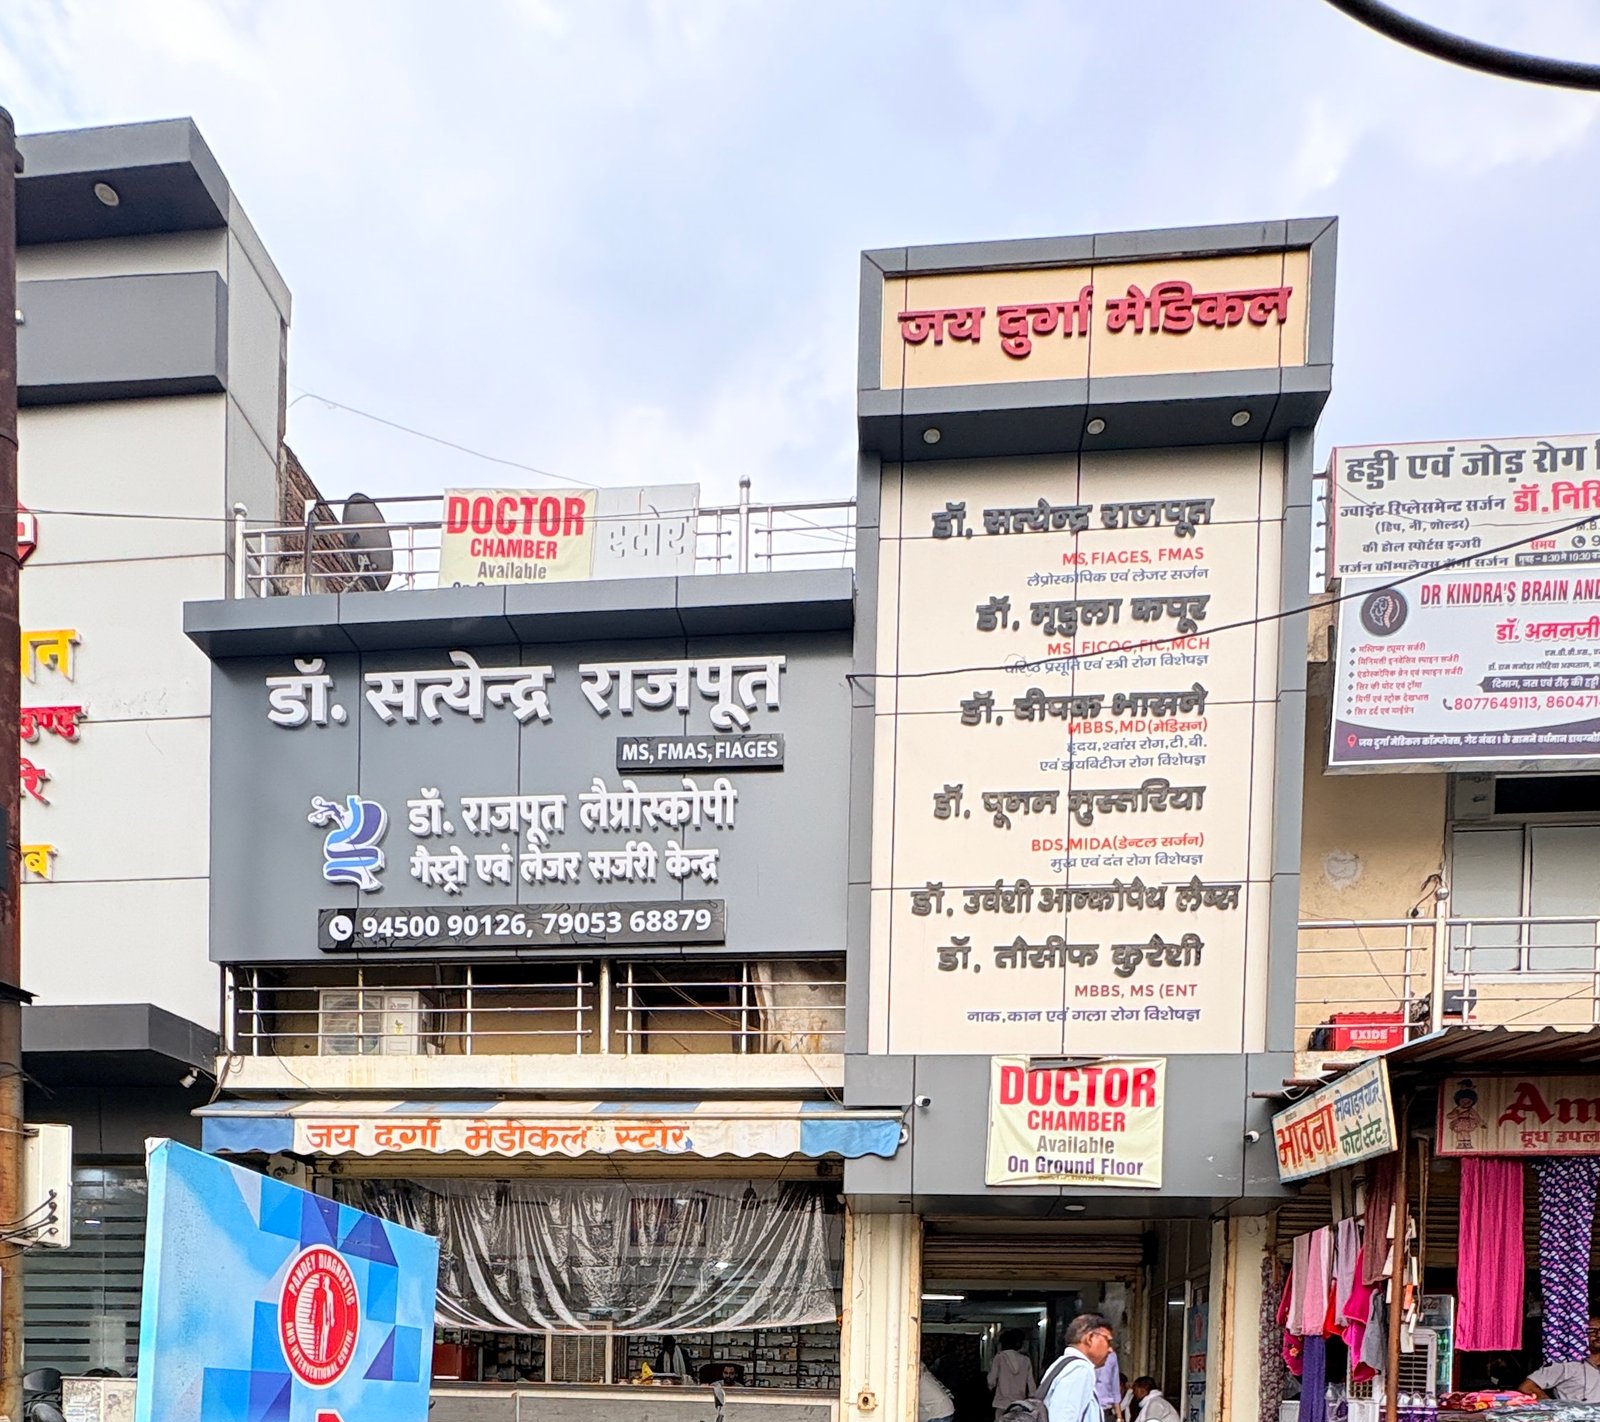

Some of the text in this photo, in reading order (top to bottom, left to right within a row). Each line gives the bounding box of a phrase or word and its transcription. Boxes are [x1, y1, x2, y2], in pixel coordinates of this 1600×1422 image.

[898, 281, 1292, 358] जय दुर्गा मेडिकल
[1345, 449, 1399, 490] हड्डी
[1406, 446, 1455, 479] एवं
[1461, 444, 1526, 483] जोड़
[1532, 441, 1587, 473] रोग
[1466, 495, 1506, 511] सर्जन
[1513, 484, 1549, 512] डॉ.
[447, 496, 586, 537] DOCTOR
[932, 498, 1215, 539] डॉ. सत्येन्द्र राजपूत
[471, 538, 557, 560] CHAMBER
[1158, 547, 1205, 561] FMAS
[1362, 541, 1378, 553] की
[1381, 540, 1404, 552] होल
[1530, 539, 1556, 550] समय
[478, 561, 547, 580] Available
[1110, 568, 1130, 583] एवं
[1132, 567, 1168, 582] लेजर
[1170, 565, 1210, 580] सर्जन
[1339, 554, 1509, 574] सर्जन सर्जन
[1421, 584, 1441, 606] DR
[1447, 581, 1516, 605] KINDRA'S
[1521, 579, 1568, 602] BRAIN
[976, 596, 1020, 631] डॉ.
[1130, 594, 1210, 634] कपूर
[1496, 618, 1519, 641] डॉ.
[1084, 656, 1104, 671] एवं
[1106, 655, 1128, 670] स्त्री
[1132, 654, 1156, 667] रोग
[1160, 652, 1209, 667] विशेषज्ञ
[265, 650, 788, 731] डॉ. सत्येन्द्र राजपूत
[960, 690, 1003, 726] डॉ.
[1014, 687, 1105, 722] दीपक
[1454, 695, 1600, 711] 8077649113, 860471
[716, 740, 779, 760] FIAGES
[1040, 757, 1059, 771] एवं
[1129, 754, 1153, 768] रोग
[1158, 752, 1206, 767] विशेषज्ञ
[406, 777, 739, 847] डॉ. राजपूत लैप्रोस्कोपी
[933, 784, 971, 820] डॉ.
[982, 788, 1060, 829] पूनम
[1161, 832, 1205, 848] सर्जन)
[410, 840, 720, 894] गैस्ट्रो एवं लेजर सर्जरी केन्द्र
[1051, 851, 1203, 874] मुख एवं दंत रोग विशेषज्ञ
[910, 881, 954, 917] डॉ.
[963, 878, 1034, 915] उर्वशी
[362, 908, 712, 940] 94500 90126, 79053 68879
[937, 935, 981, 974] डॉ.
[1074, 983, 1198, 999] MBBS, MS (ENT
[1046, 1005, 1201, 1022] एवं गला रोग विशेषज्ञ
[1350, 1029, 1388, 1040] EXIDE
[1000, 1065, 1156, 1108] DOCTOR
[1027, 1110, 1125, 1132] CHAMBER
[307, 1123, 360, 1149] जय
[615, 1119, 690, 1151] स्टोर
[1037, 1135, 1114, 1154] Available
[1276, 1102, 1337, 1167] भावना
[1520, 1131, 1551, 1148] दूध
[1008, 1155, 1143, 1175] On Ground Floor
[288, 1253, 356, 1306] PANDEY DIAGNOSTIC
[285, 1321, 296, 1343] AND
[290, 1347, 340, 1380] INTERVENTIONAL
